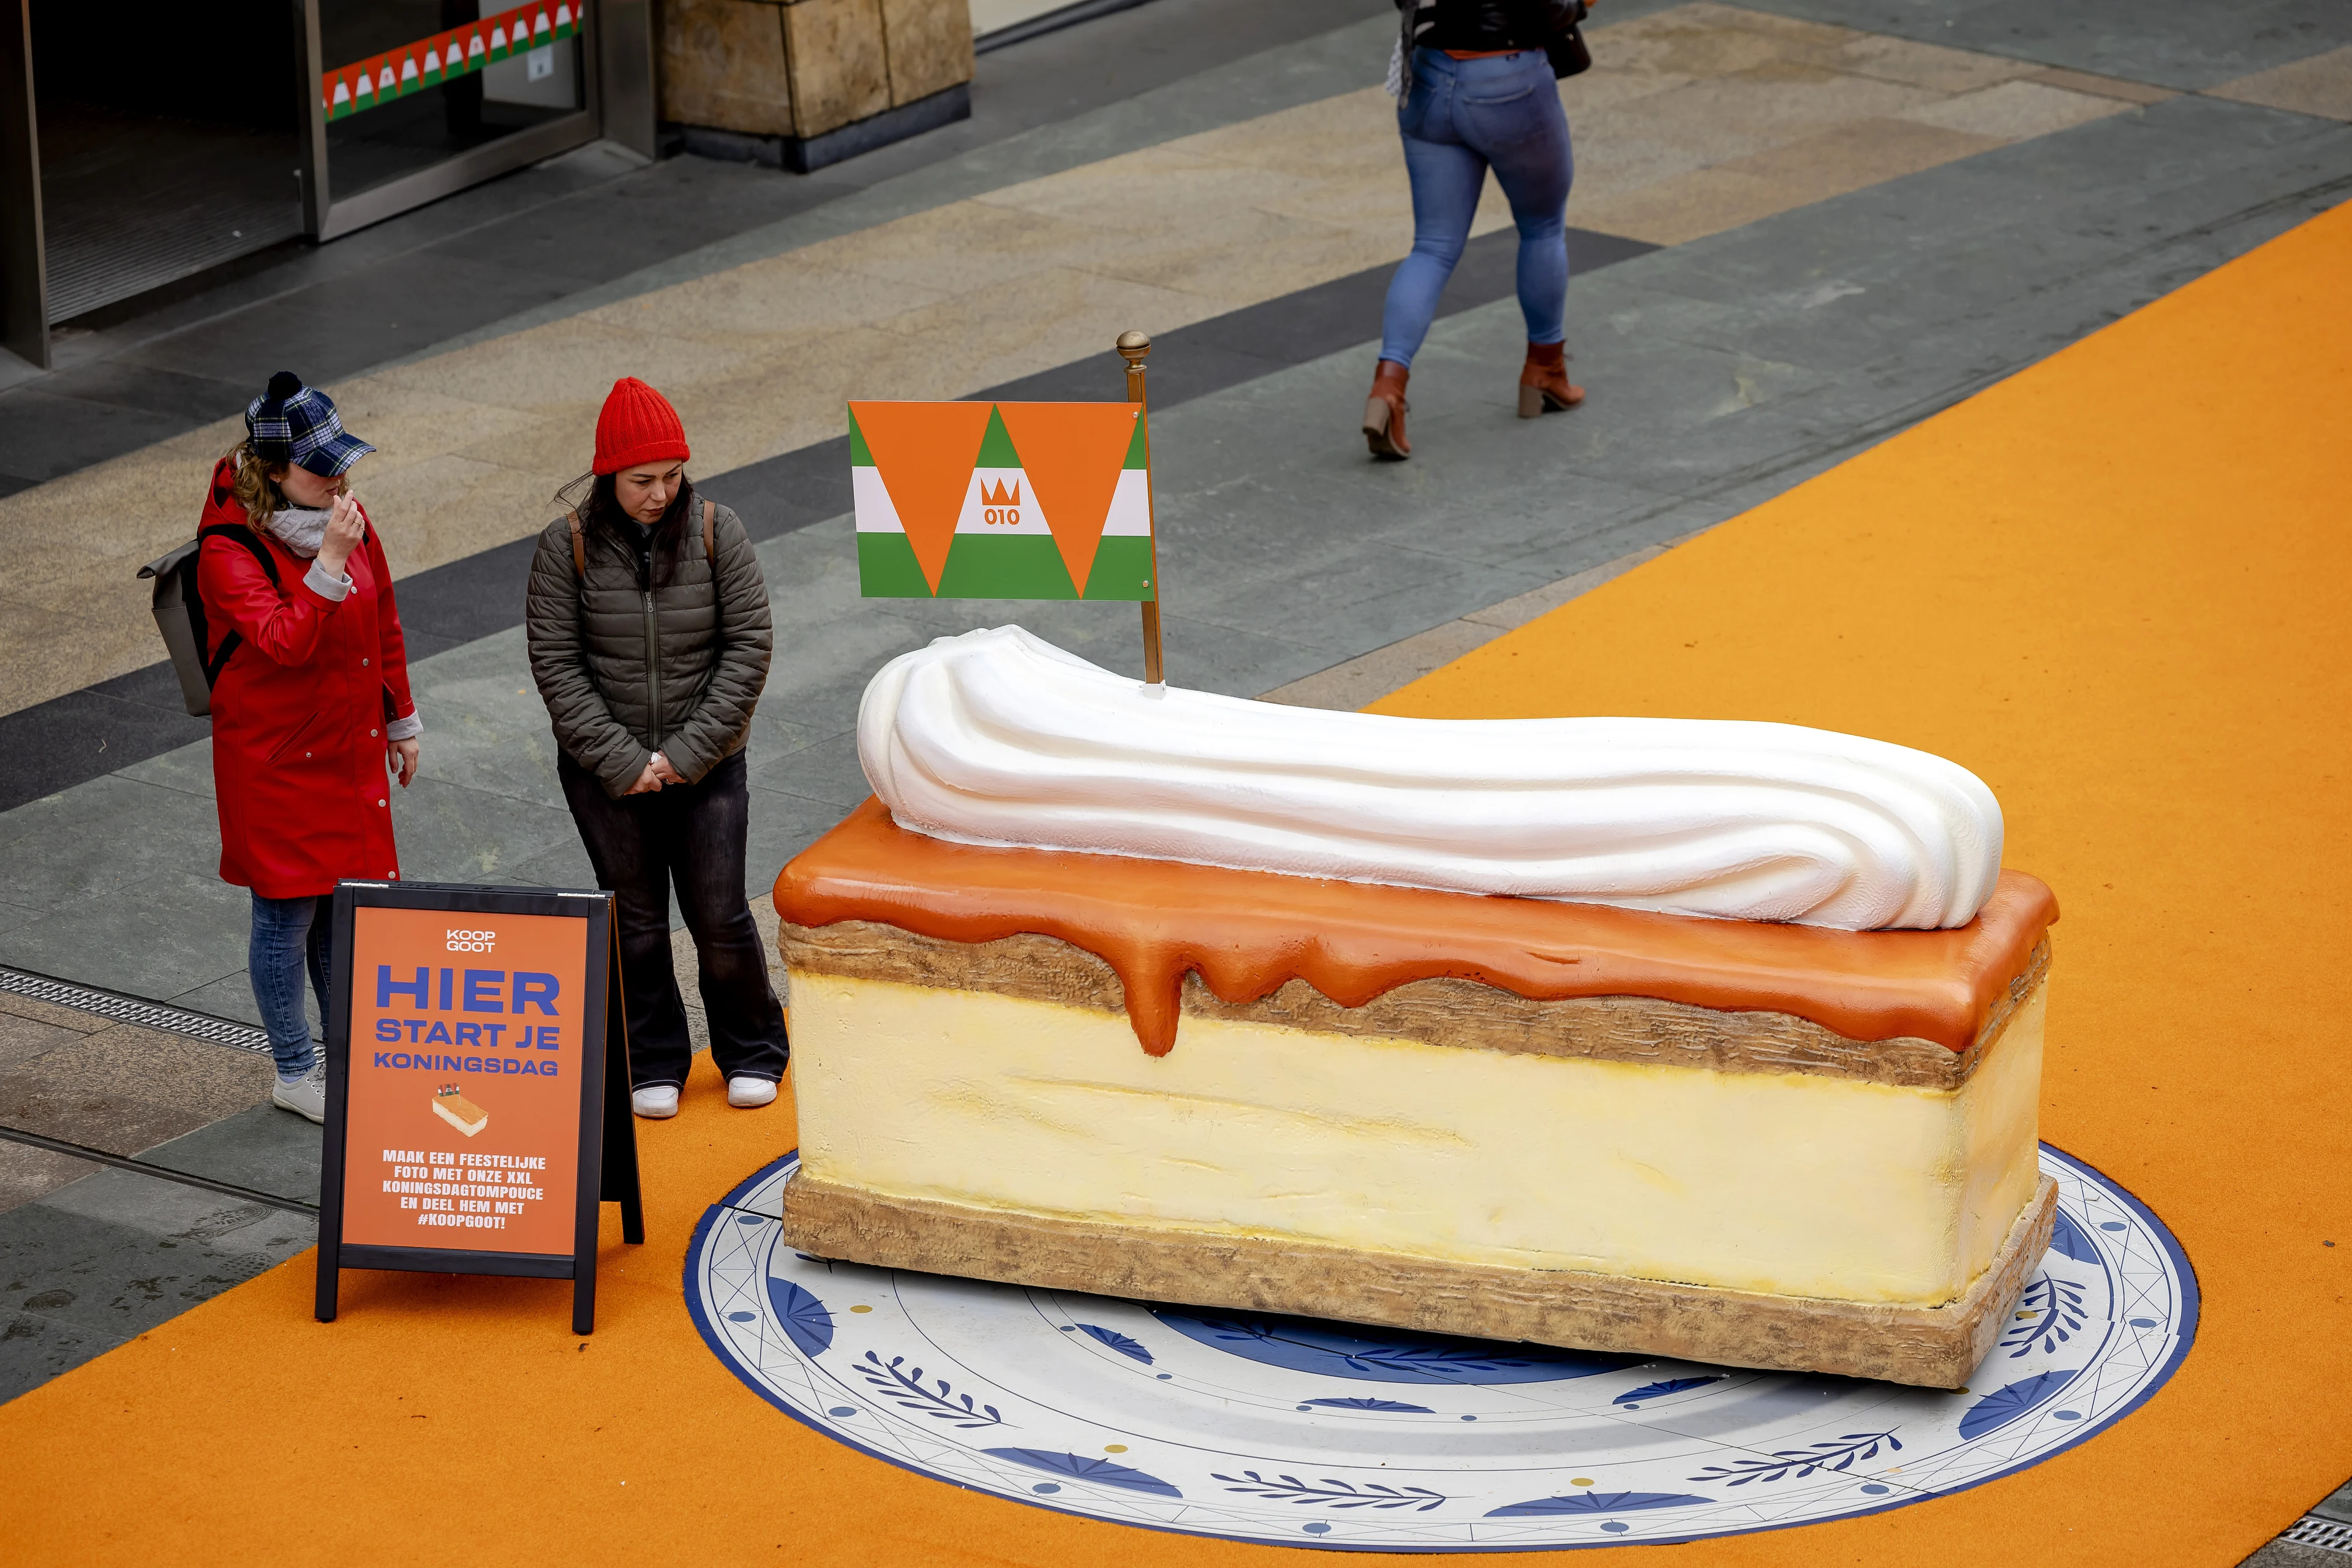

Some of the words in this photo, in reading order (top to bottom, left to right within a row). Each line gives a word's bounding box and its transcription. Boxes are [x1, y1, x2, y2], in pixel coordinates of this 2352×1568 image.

[984, 508, 1020, 526] 010
[447, 929, 496, 941] KOOP
[446, 940, 496, 953] GOOT
[376, 965, 560, 1016] HIER
[375, 1019, 507, 1047] START
[515, 1025, 560, 1050] JE
[374, 1052, 558, 1077] KONINGSDAG
[383, 1149, 424, 1164] MAAK
[429, 1152, 454, 1165] EEN
[459, 1153, 546, 1170] FEESTELIJKE
[394, 1166, 428, 1179] FOTO
[433, 1167, 463, 1181] MET
[467, 1169, 502, 1183] ONZE
[507, 1171, 533, 1185] XXL
[382, 1180, 543, 1200] KONINGSDAGTOMPOUCE
[401, 1196, 418, 1209] EN
[422, 1197, 455, 1211] DEEL
[459, 1199, 491, 1213] HEM
[495, 1201, 524, 1215] MET
[418, 1213, 505, 1229] #KOOPGOOT!
